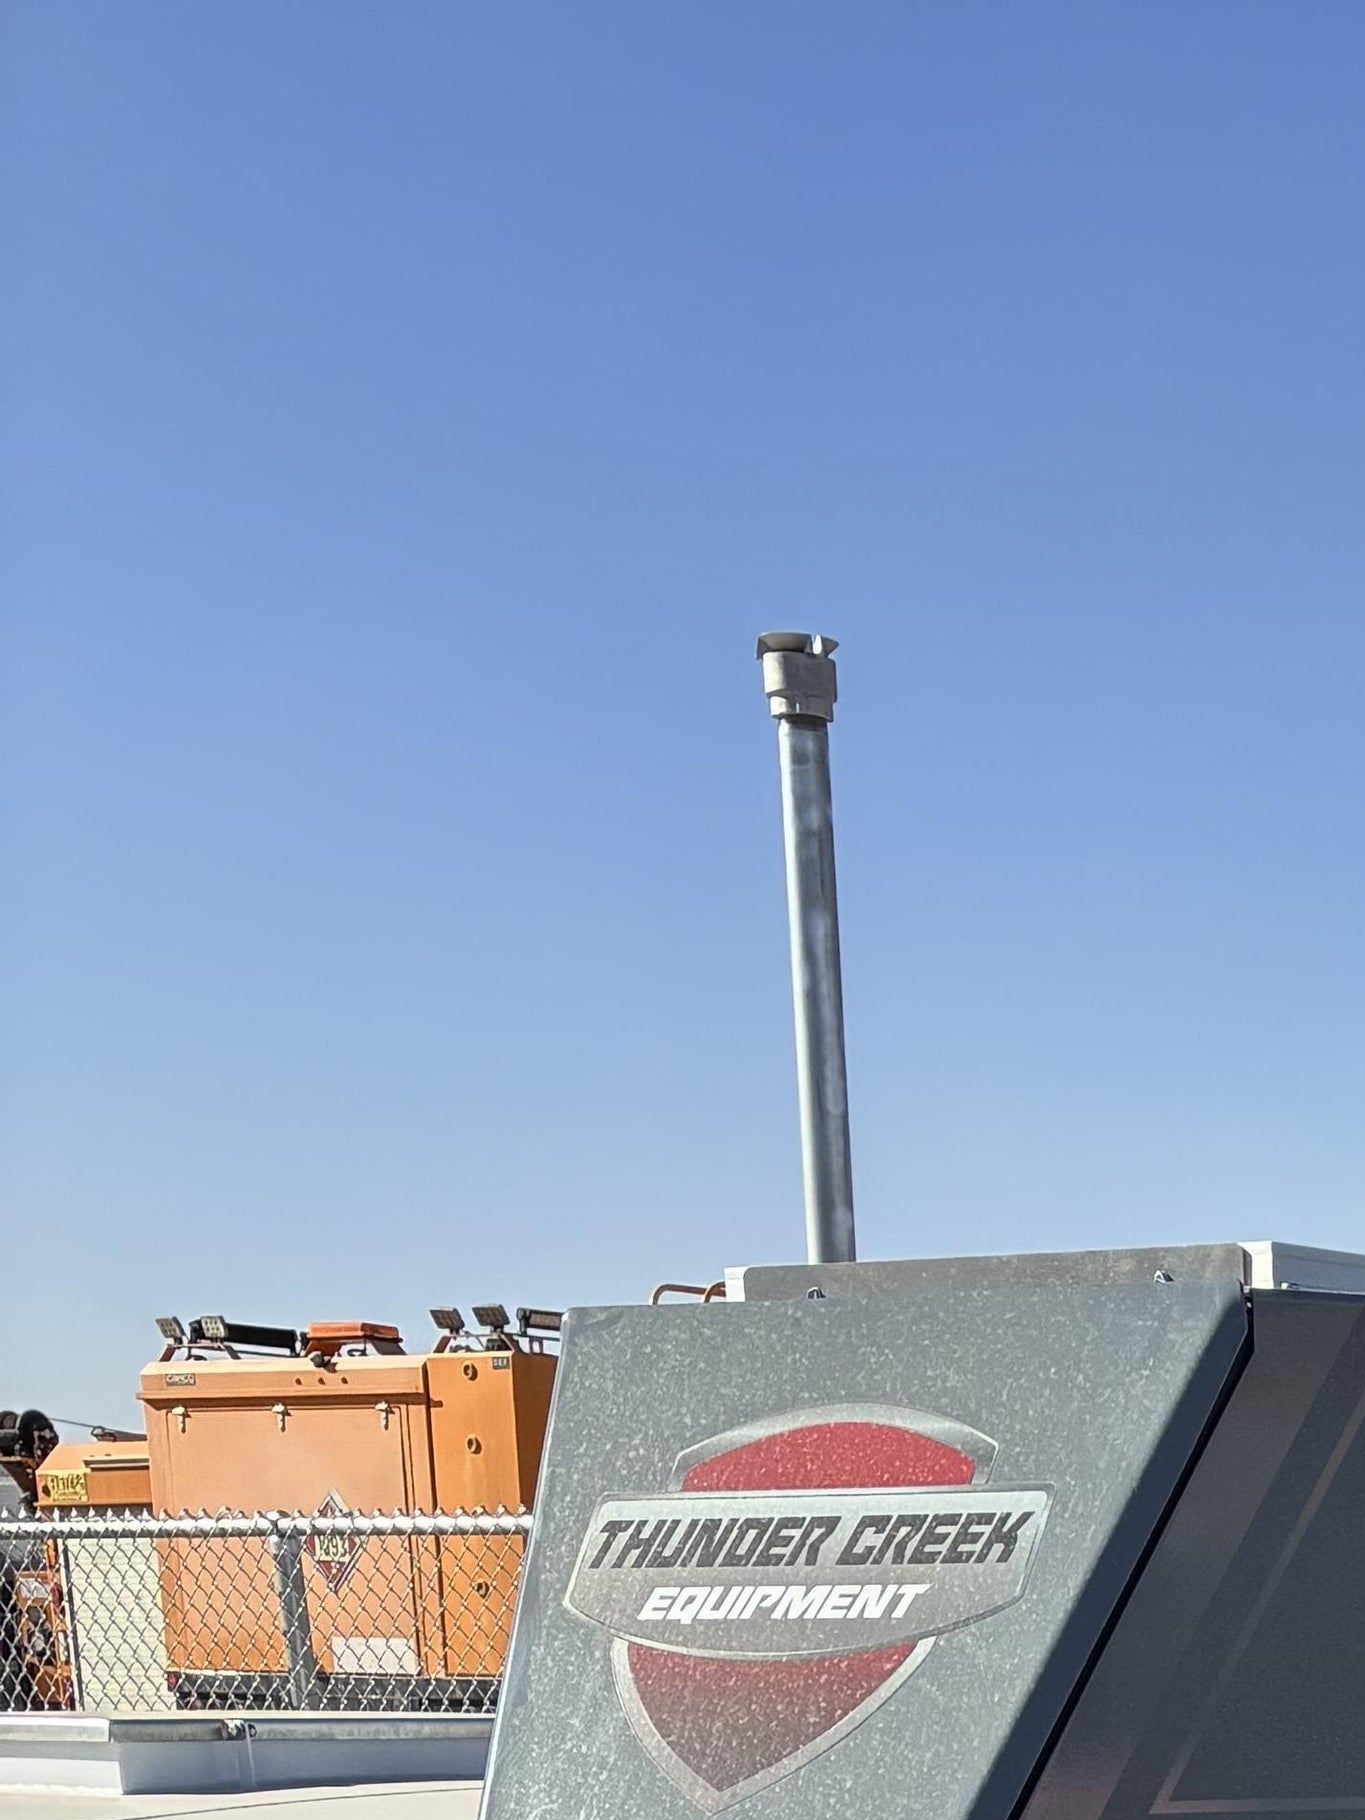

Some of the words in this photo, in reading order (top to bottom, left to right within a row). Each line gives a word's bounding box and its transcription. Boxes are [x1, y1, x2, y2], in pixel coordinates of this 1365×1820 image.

[589, 1515, 836, 1569] THUNDER
[835, 1511, 1035, 1566] CREEK
[637, 1583, 933, 1625] EQUIPMENT
